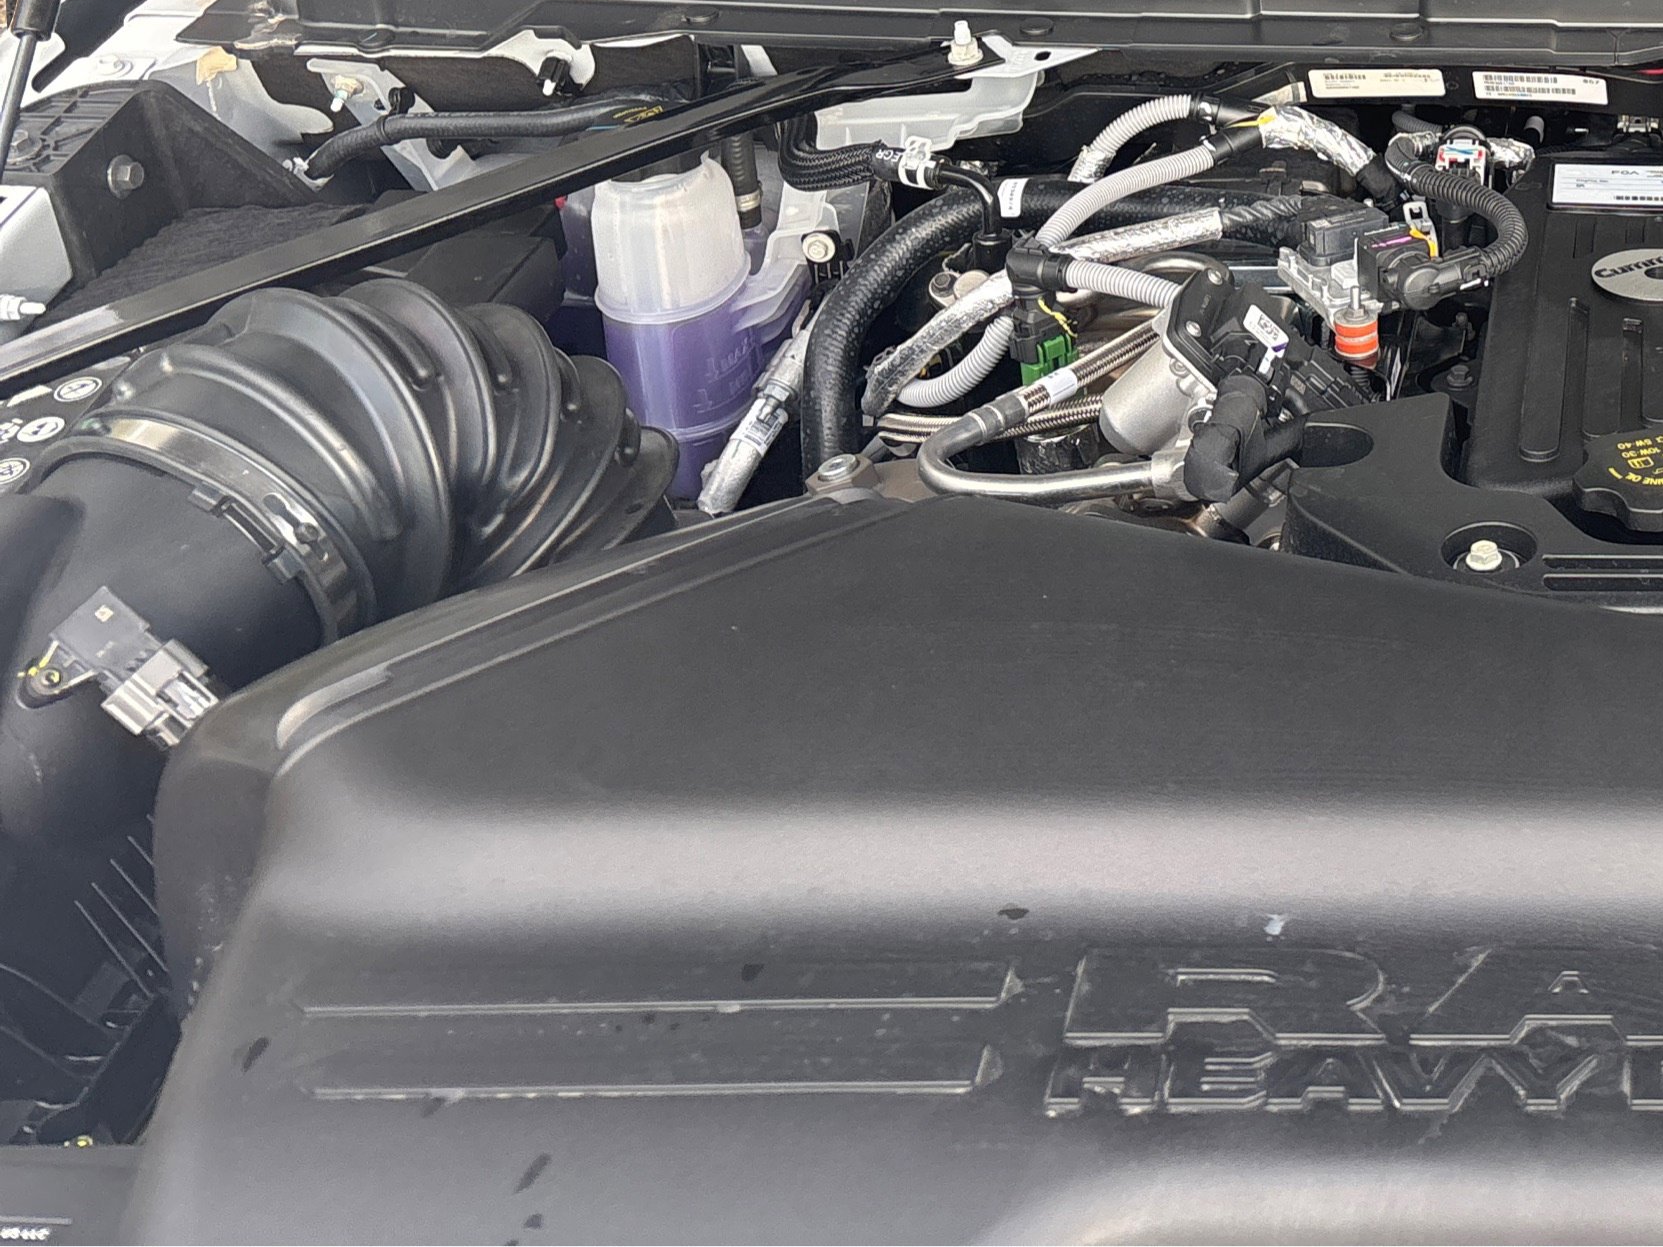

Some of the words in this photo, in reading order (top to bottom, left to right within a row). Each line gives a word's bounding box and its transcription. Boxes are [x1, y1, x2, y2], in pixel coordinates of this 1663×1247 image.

[1617, 438, 1653, 450] 5W-40
[1621, 446, 1662, 458] 10W-30
[1044, 1050, 1604, 1114] HEAVY
